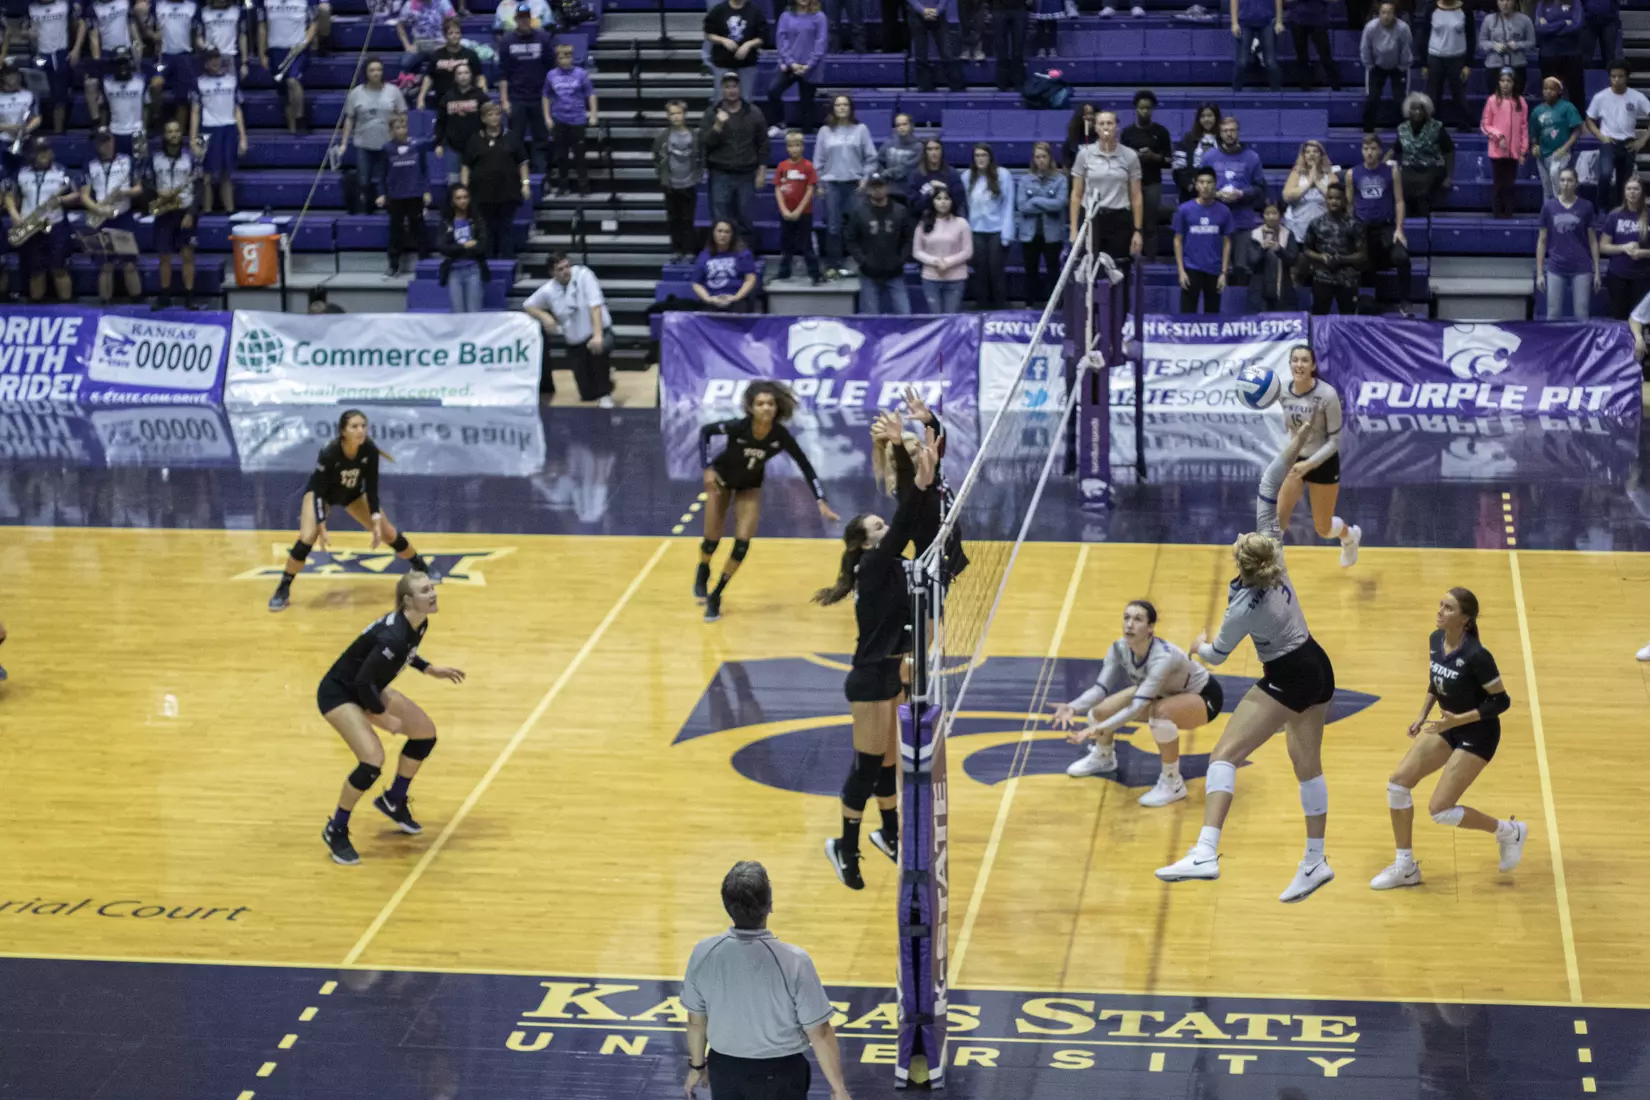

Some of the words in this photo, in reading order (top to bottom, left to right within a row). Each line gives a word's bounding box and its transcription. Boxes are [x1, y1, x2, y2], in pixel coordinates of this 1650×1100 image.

[131, 323, 196, 340] KANSAS
[984, 321, 1022, 336] STAY
[1158, 321, 1219, 337] K-STATE
[1221, 318, 1303, 338] ATHLETICS
[135, 340, 212, 372] 00000
[292, 341, 448, 367] Commerce
[458, 338, 530, 366] Bank
[703, 378, 869, 406] PPLE
[1357, 381, 1528, 410] PURPLE
[1538, 385, 1612, 411] PIT
[97, 900, 252, 921] Court
[522, 981, 981, 1032] KAAS
[1015, 997, 1361, 1044] STATE
